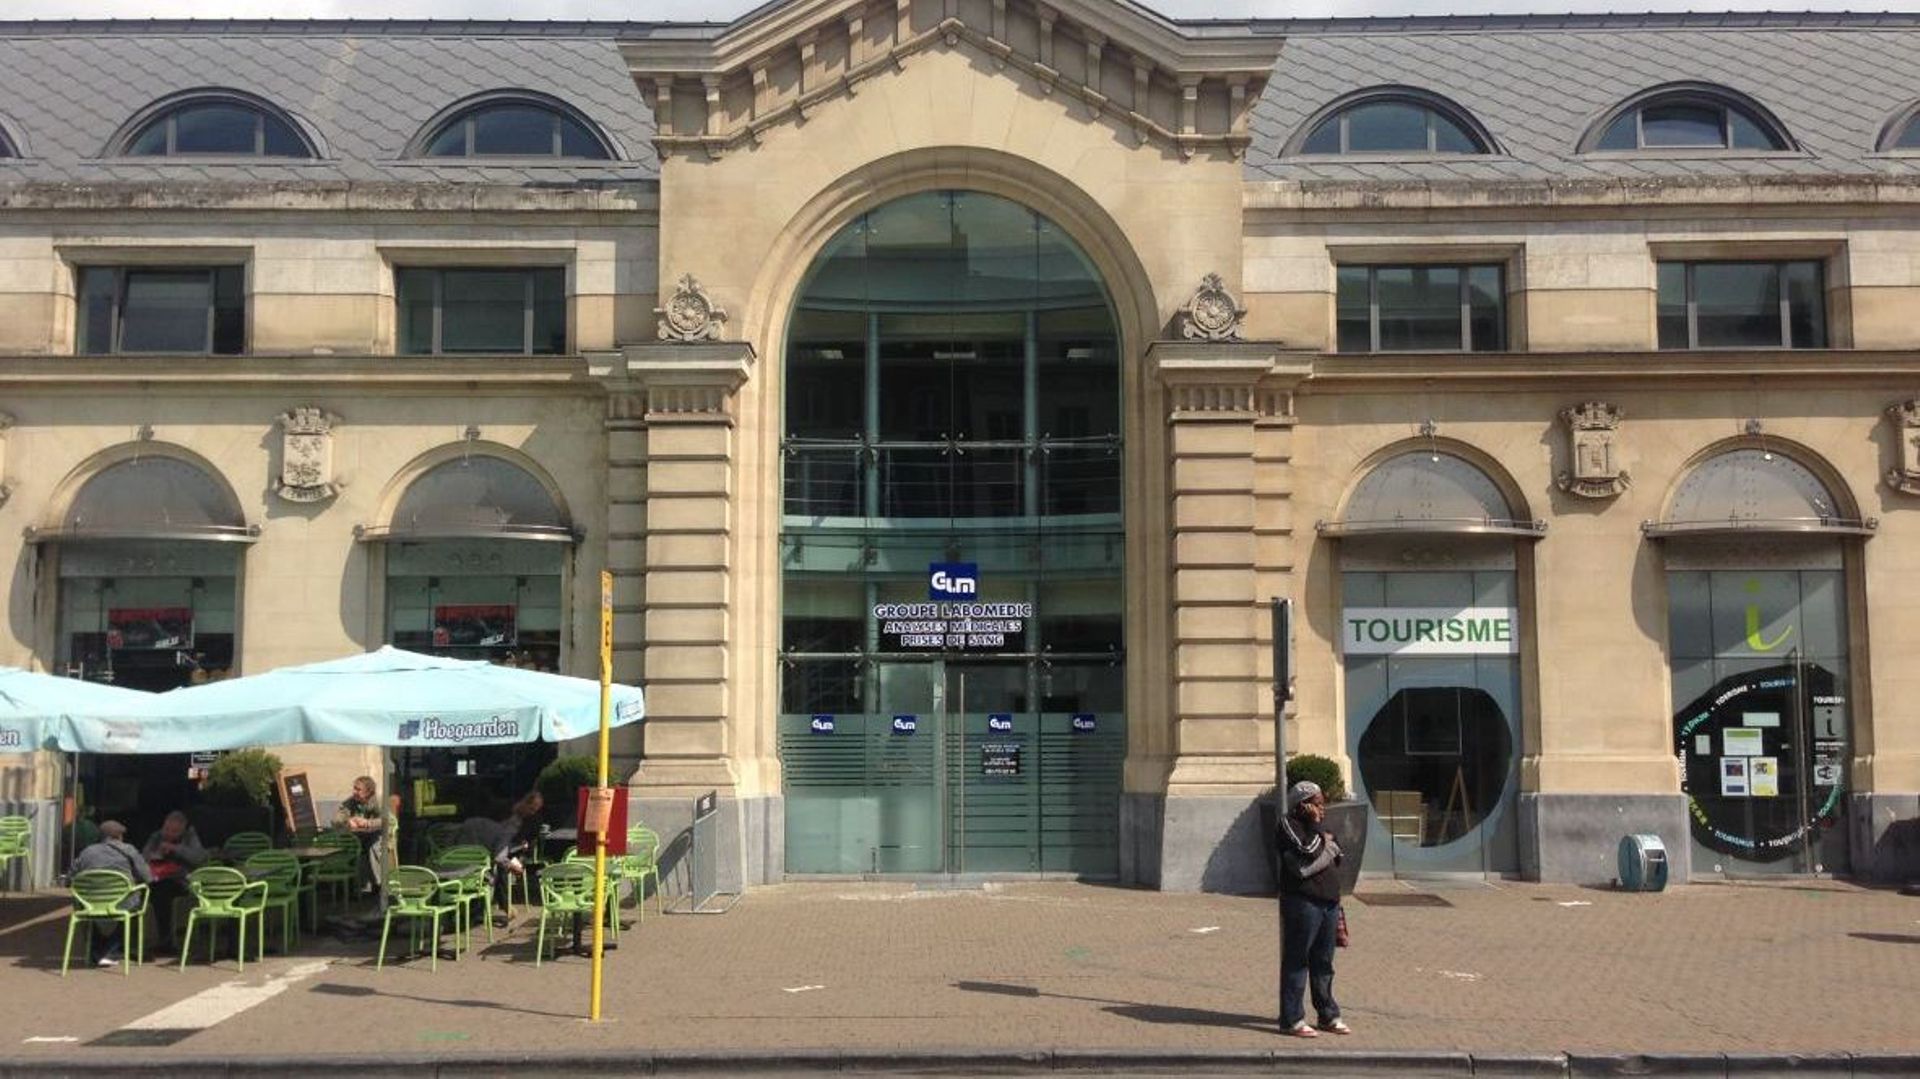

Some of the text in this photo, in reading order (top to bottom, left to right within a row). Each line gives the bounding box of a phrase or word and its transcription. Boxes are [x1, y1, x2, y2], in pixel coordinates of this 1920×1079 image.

[874, 603, 1032, 618] GROUPE LABOMEDIC
[883, 620, 947, 634] ANALYSES
[1349, 618, 1512, 642] TOURISME
[900, 634, 1004, 647] PRISES DE SANG
[422, 716, 519, 741] Hoegaarden
